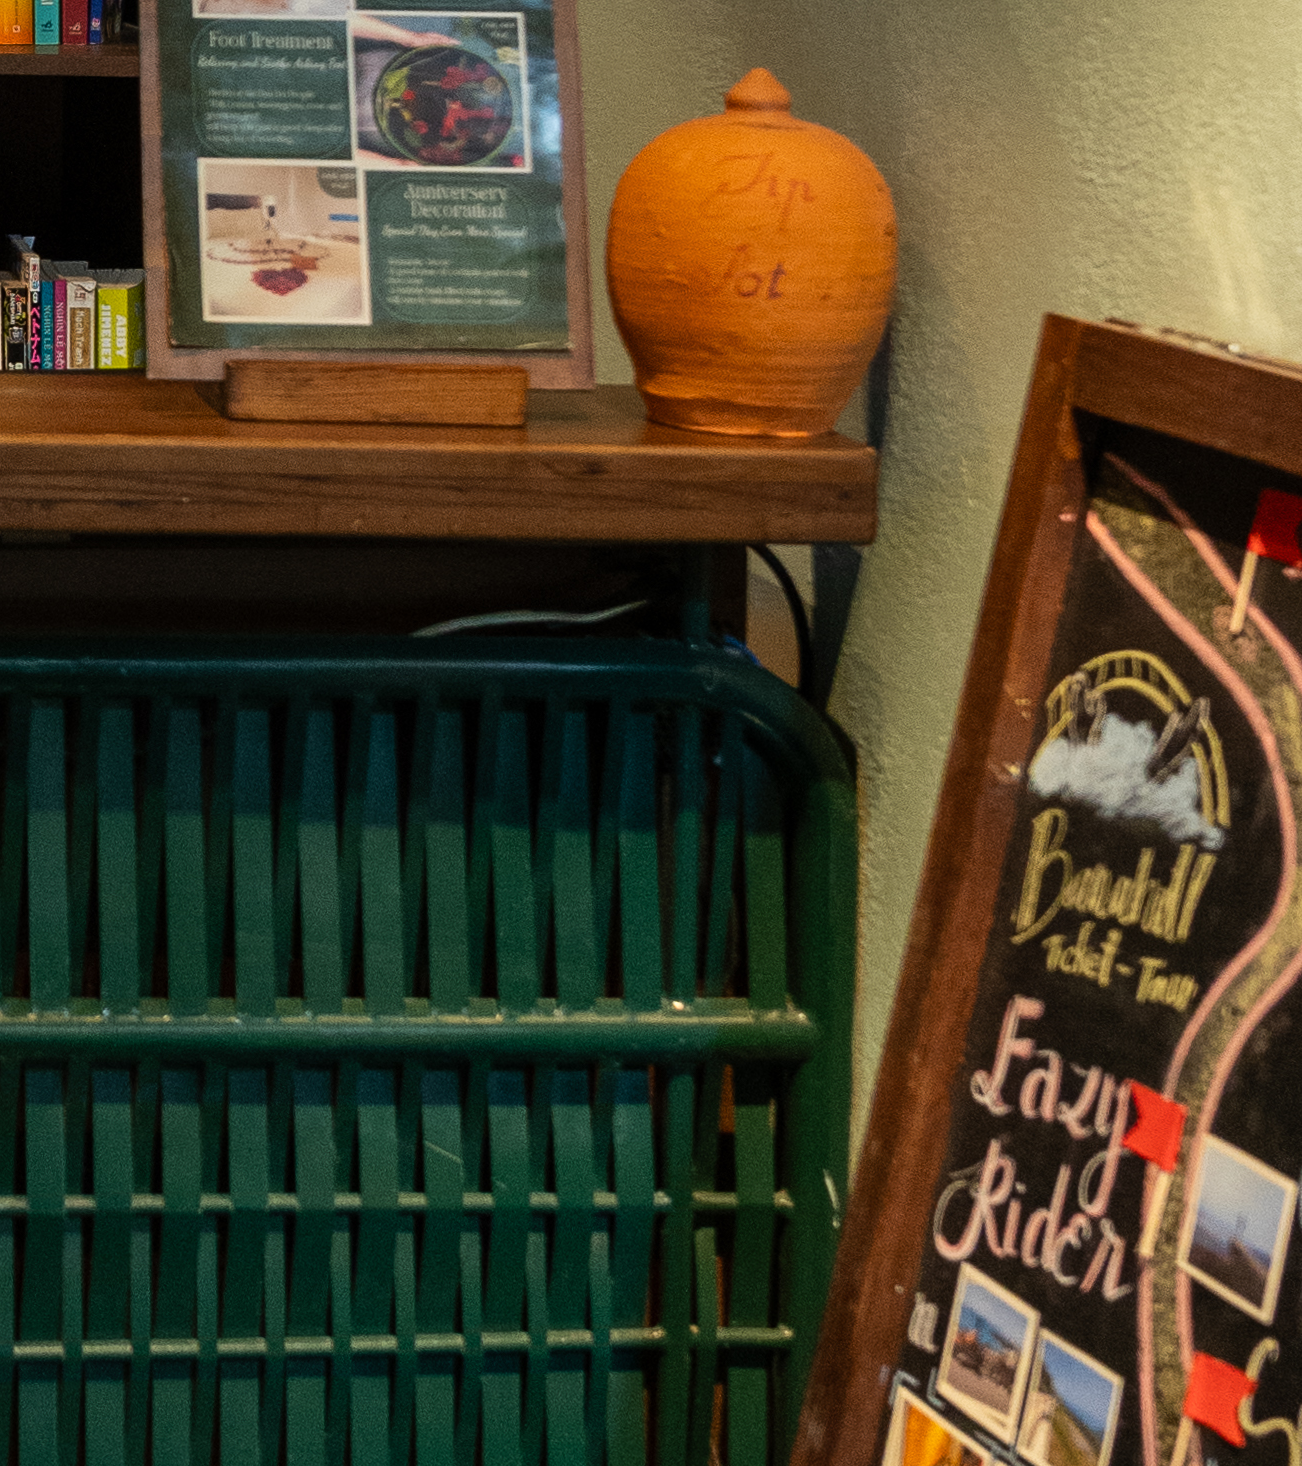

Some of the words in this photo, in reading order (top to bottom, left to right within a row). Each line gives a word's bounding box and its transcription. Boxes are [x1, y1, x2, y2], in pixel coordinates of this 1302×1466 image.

[208, 30, 245, 50] Foot
[249, 30, 334, 50] Treatment
[932, 1137, 1133, 1302] Rider
